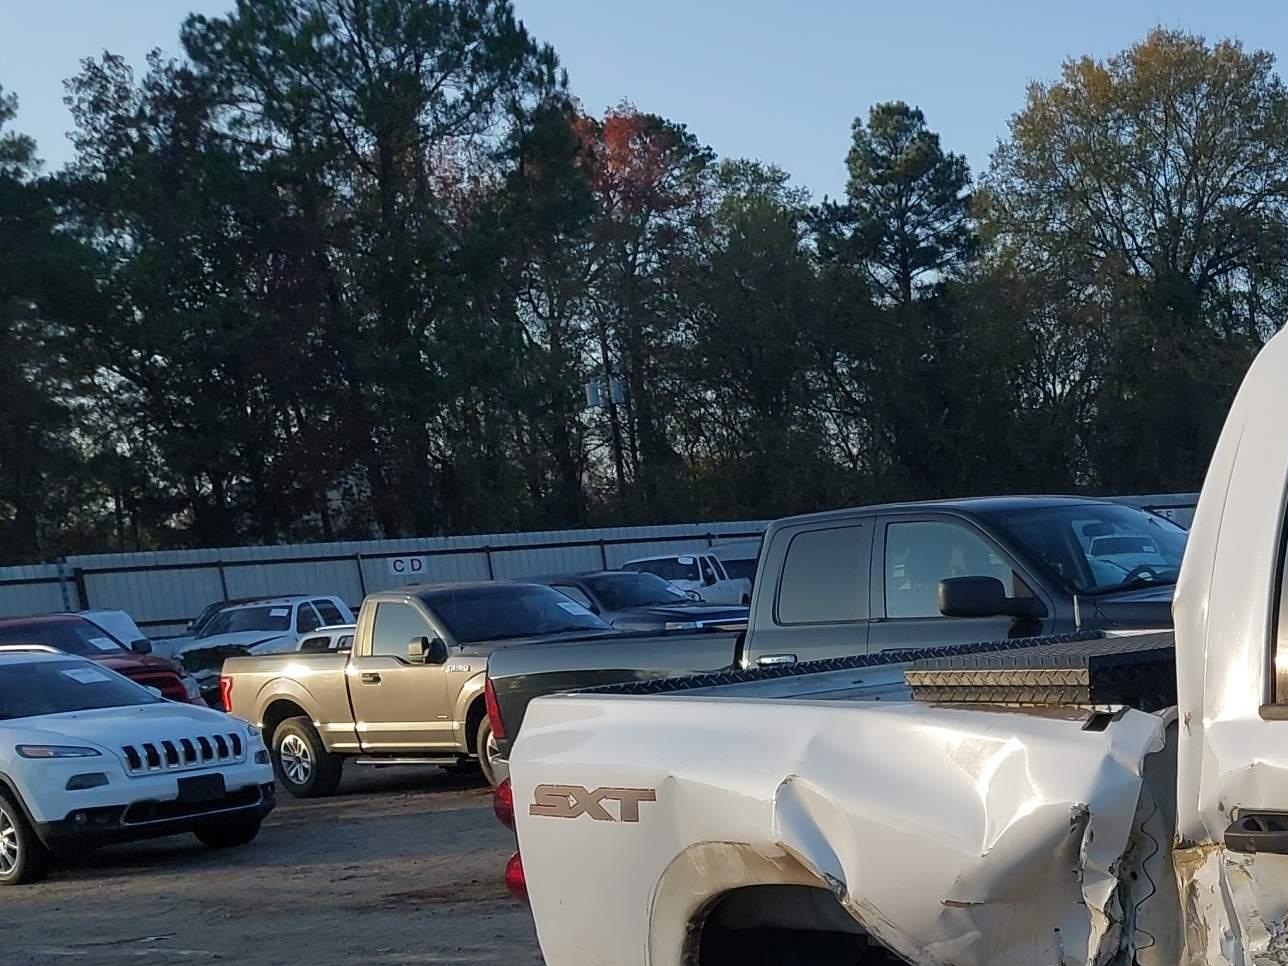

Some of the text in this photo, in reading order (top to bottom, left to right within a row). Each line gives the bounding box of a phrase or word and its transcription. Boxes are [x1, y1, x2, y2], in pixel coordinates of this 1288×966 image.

[393, 558, 422, 572] C D
[529, 783, 656, 822] SXT
